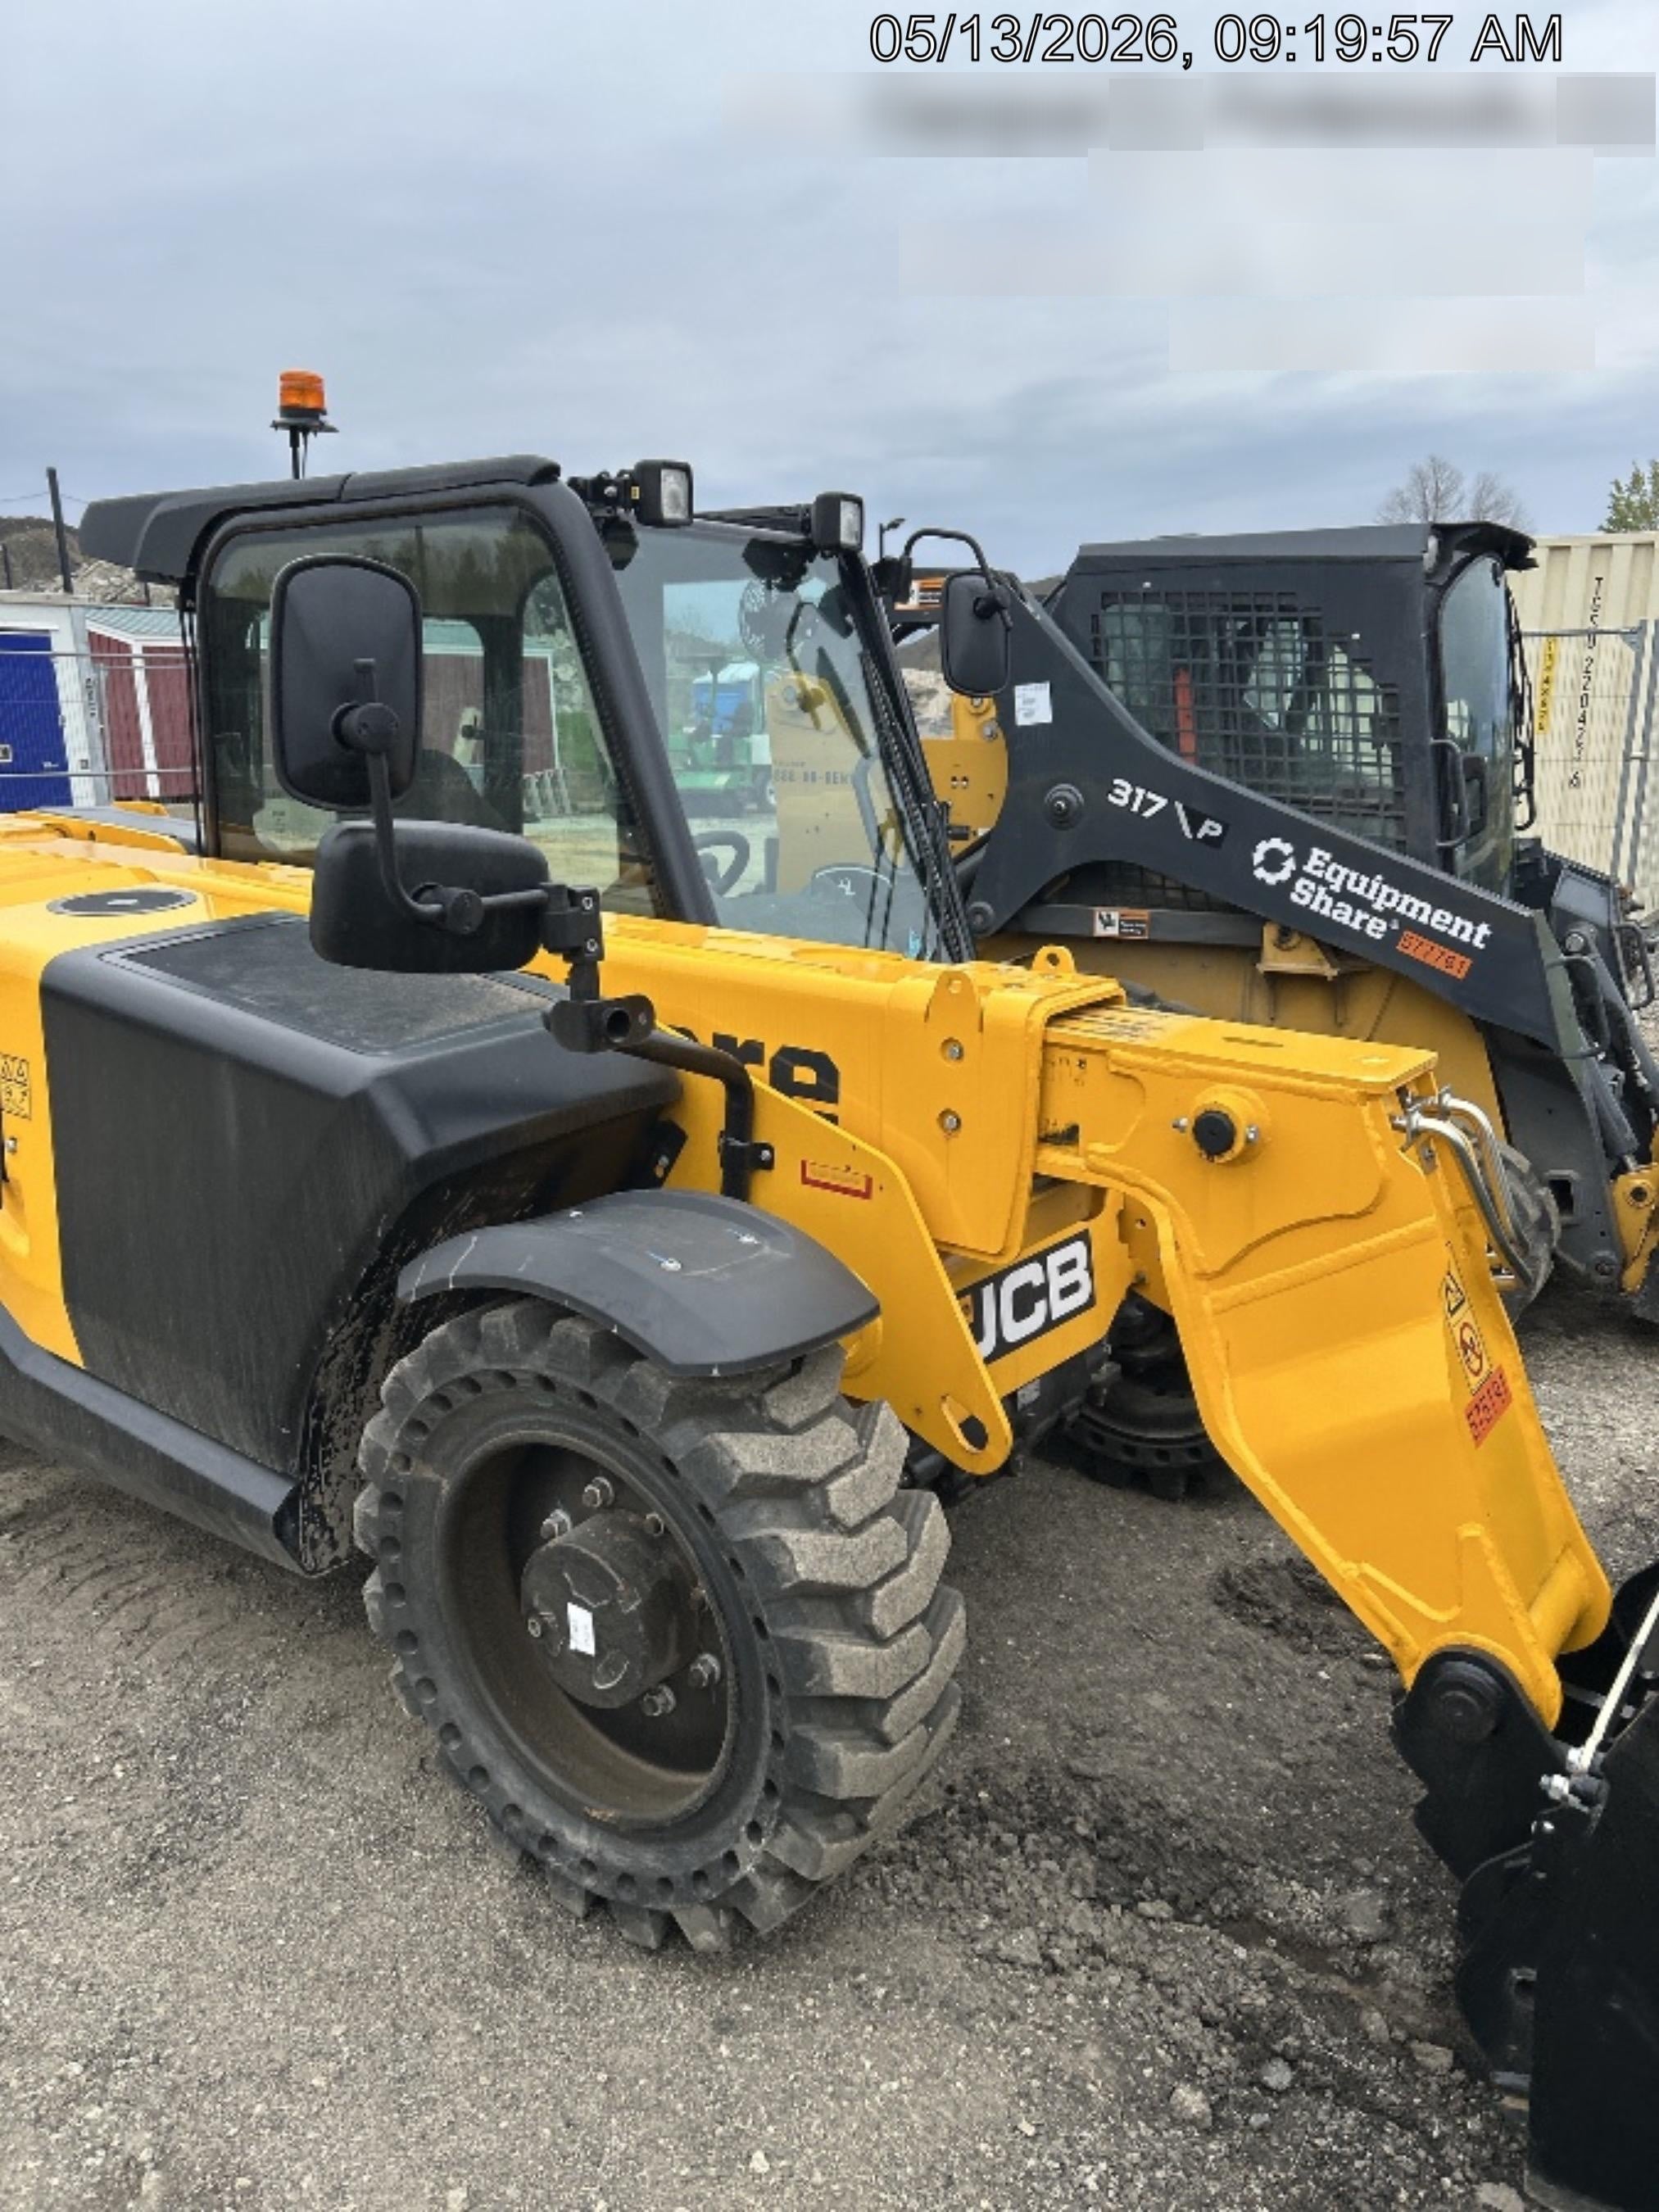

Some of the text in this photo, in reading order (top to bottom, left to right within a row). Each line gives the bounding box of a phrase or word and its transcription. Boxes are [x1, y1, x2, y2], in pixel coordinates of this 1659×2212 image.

[1108, 778, 1223, 839] 317 P
[1303, 846, 1493, 950] Equipment
[976, 1240, 1093, 1360] JCB
